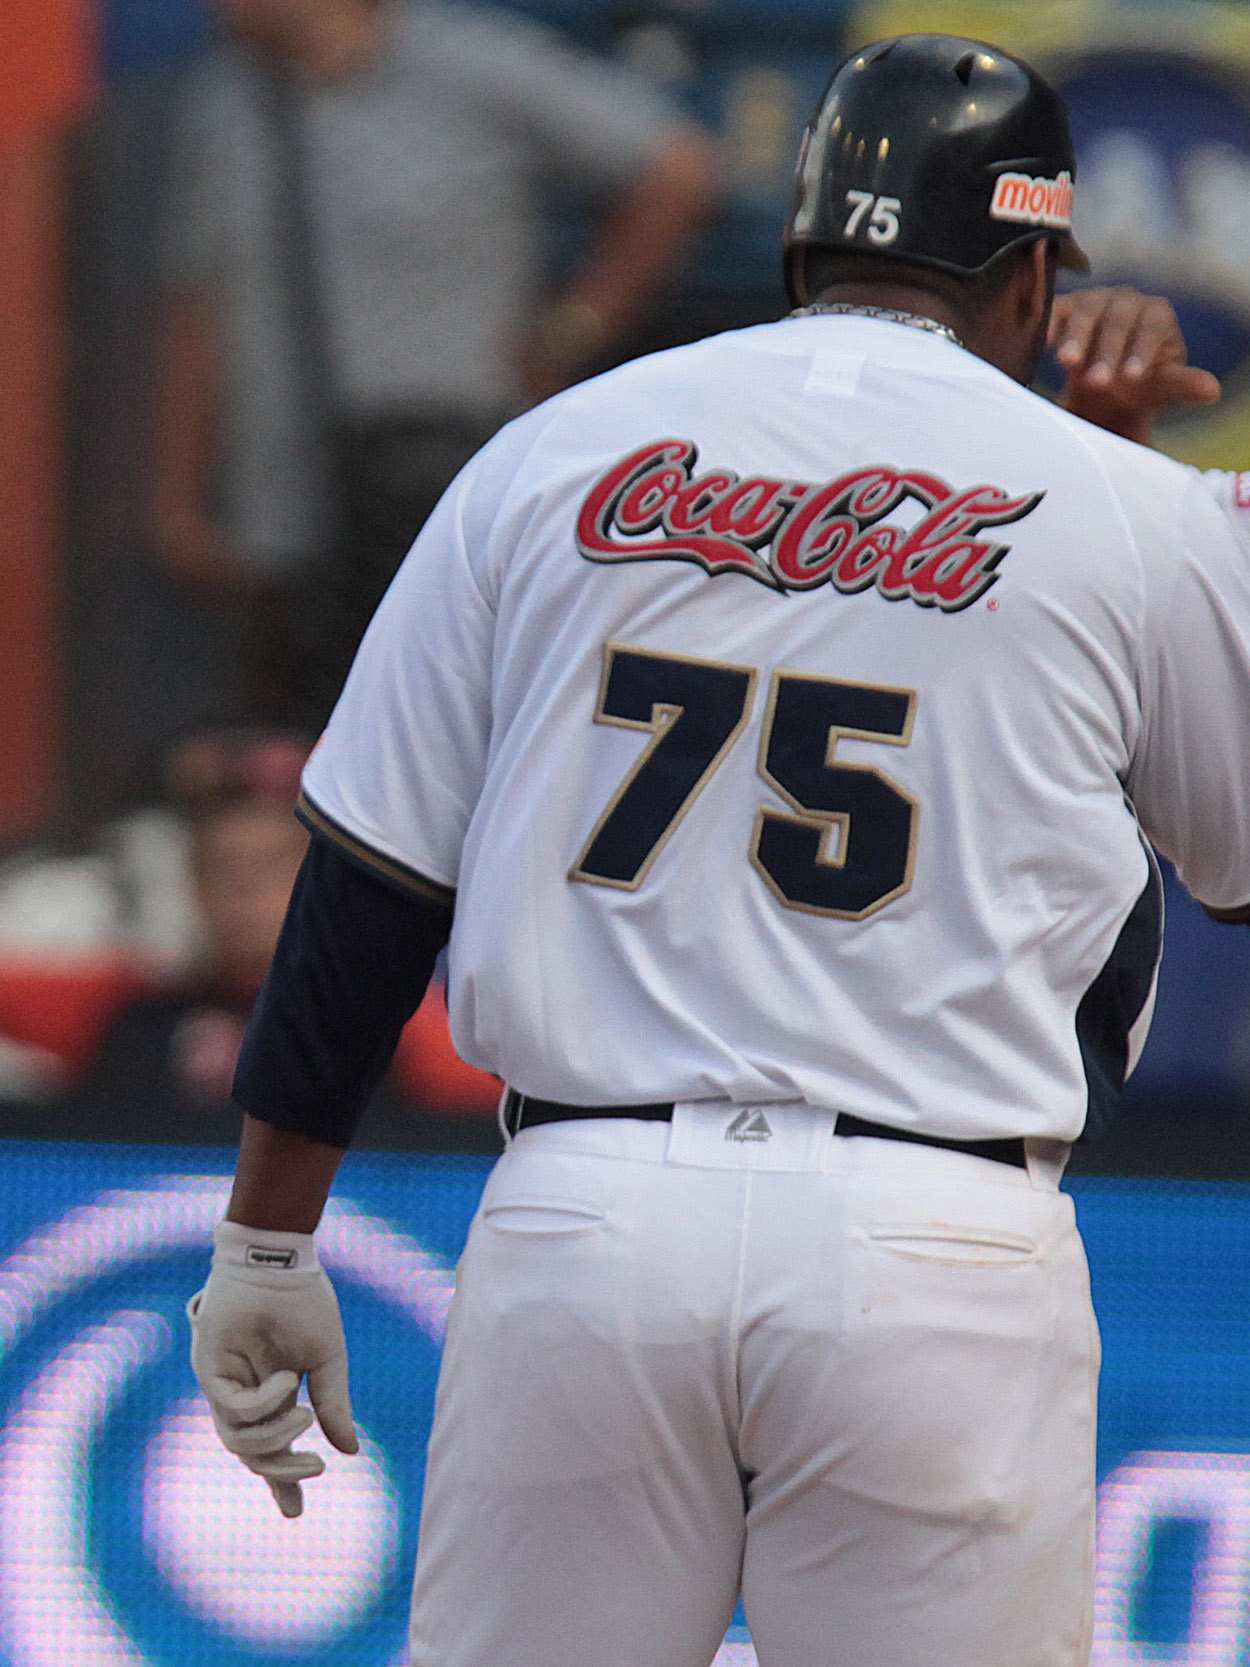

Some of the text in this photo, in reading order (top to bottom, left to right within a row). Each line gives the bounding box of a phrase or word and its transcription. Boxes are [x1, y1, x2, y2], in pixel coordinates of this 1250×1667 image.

[844, 189, 902, 246] 75
[575, 437, 1048, 613] Coca-Cola
[568, 641, 919, 921] 75
